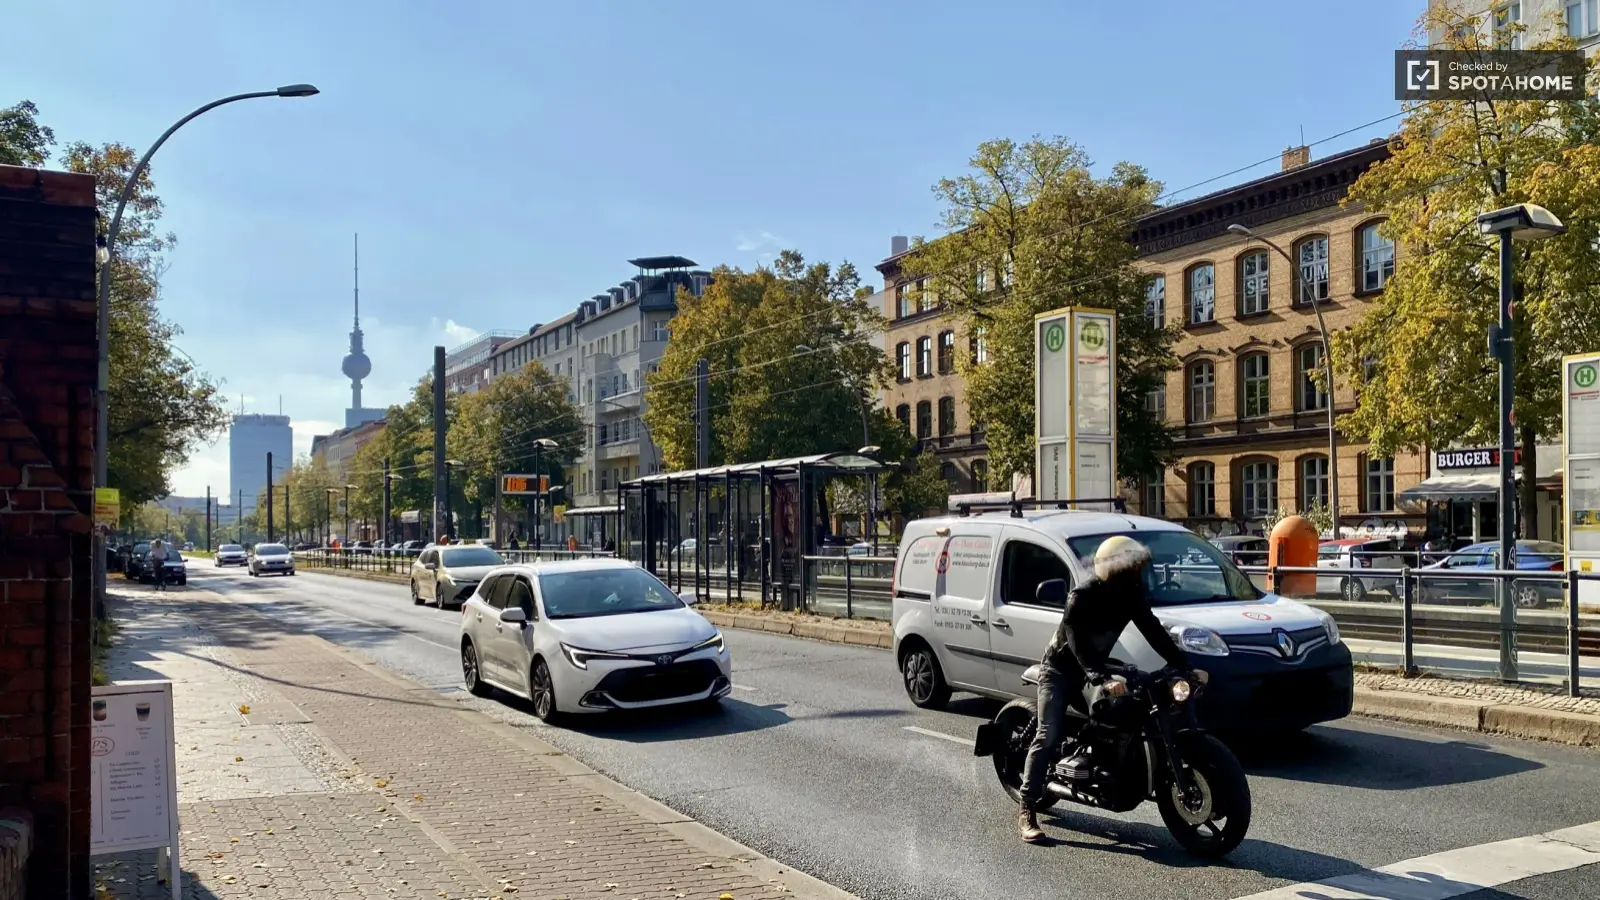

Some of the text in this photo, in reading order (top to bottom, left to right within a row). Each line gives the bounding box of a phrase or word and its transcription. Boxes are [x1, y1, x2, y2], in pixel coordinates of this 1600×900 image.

[1051, 330, 1059, 346] H
[1580, 370, 1590, 382] H
[1438, 451, 1491, 468] BURGER
